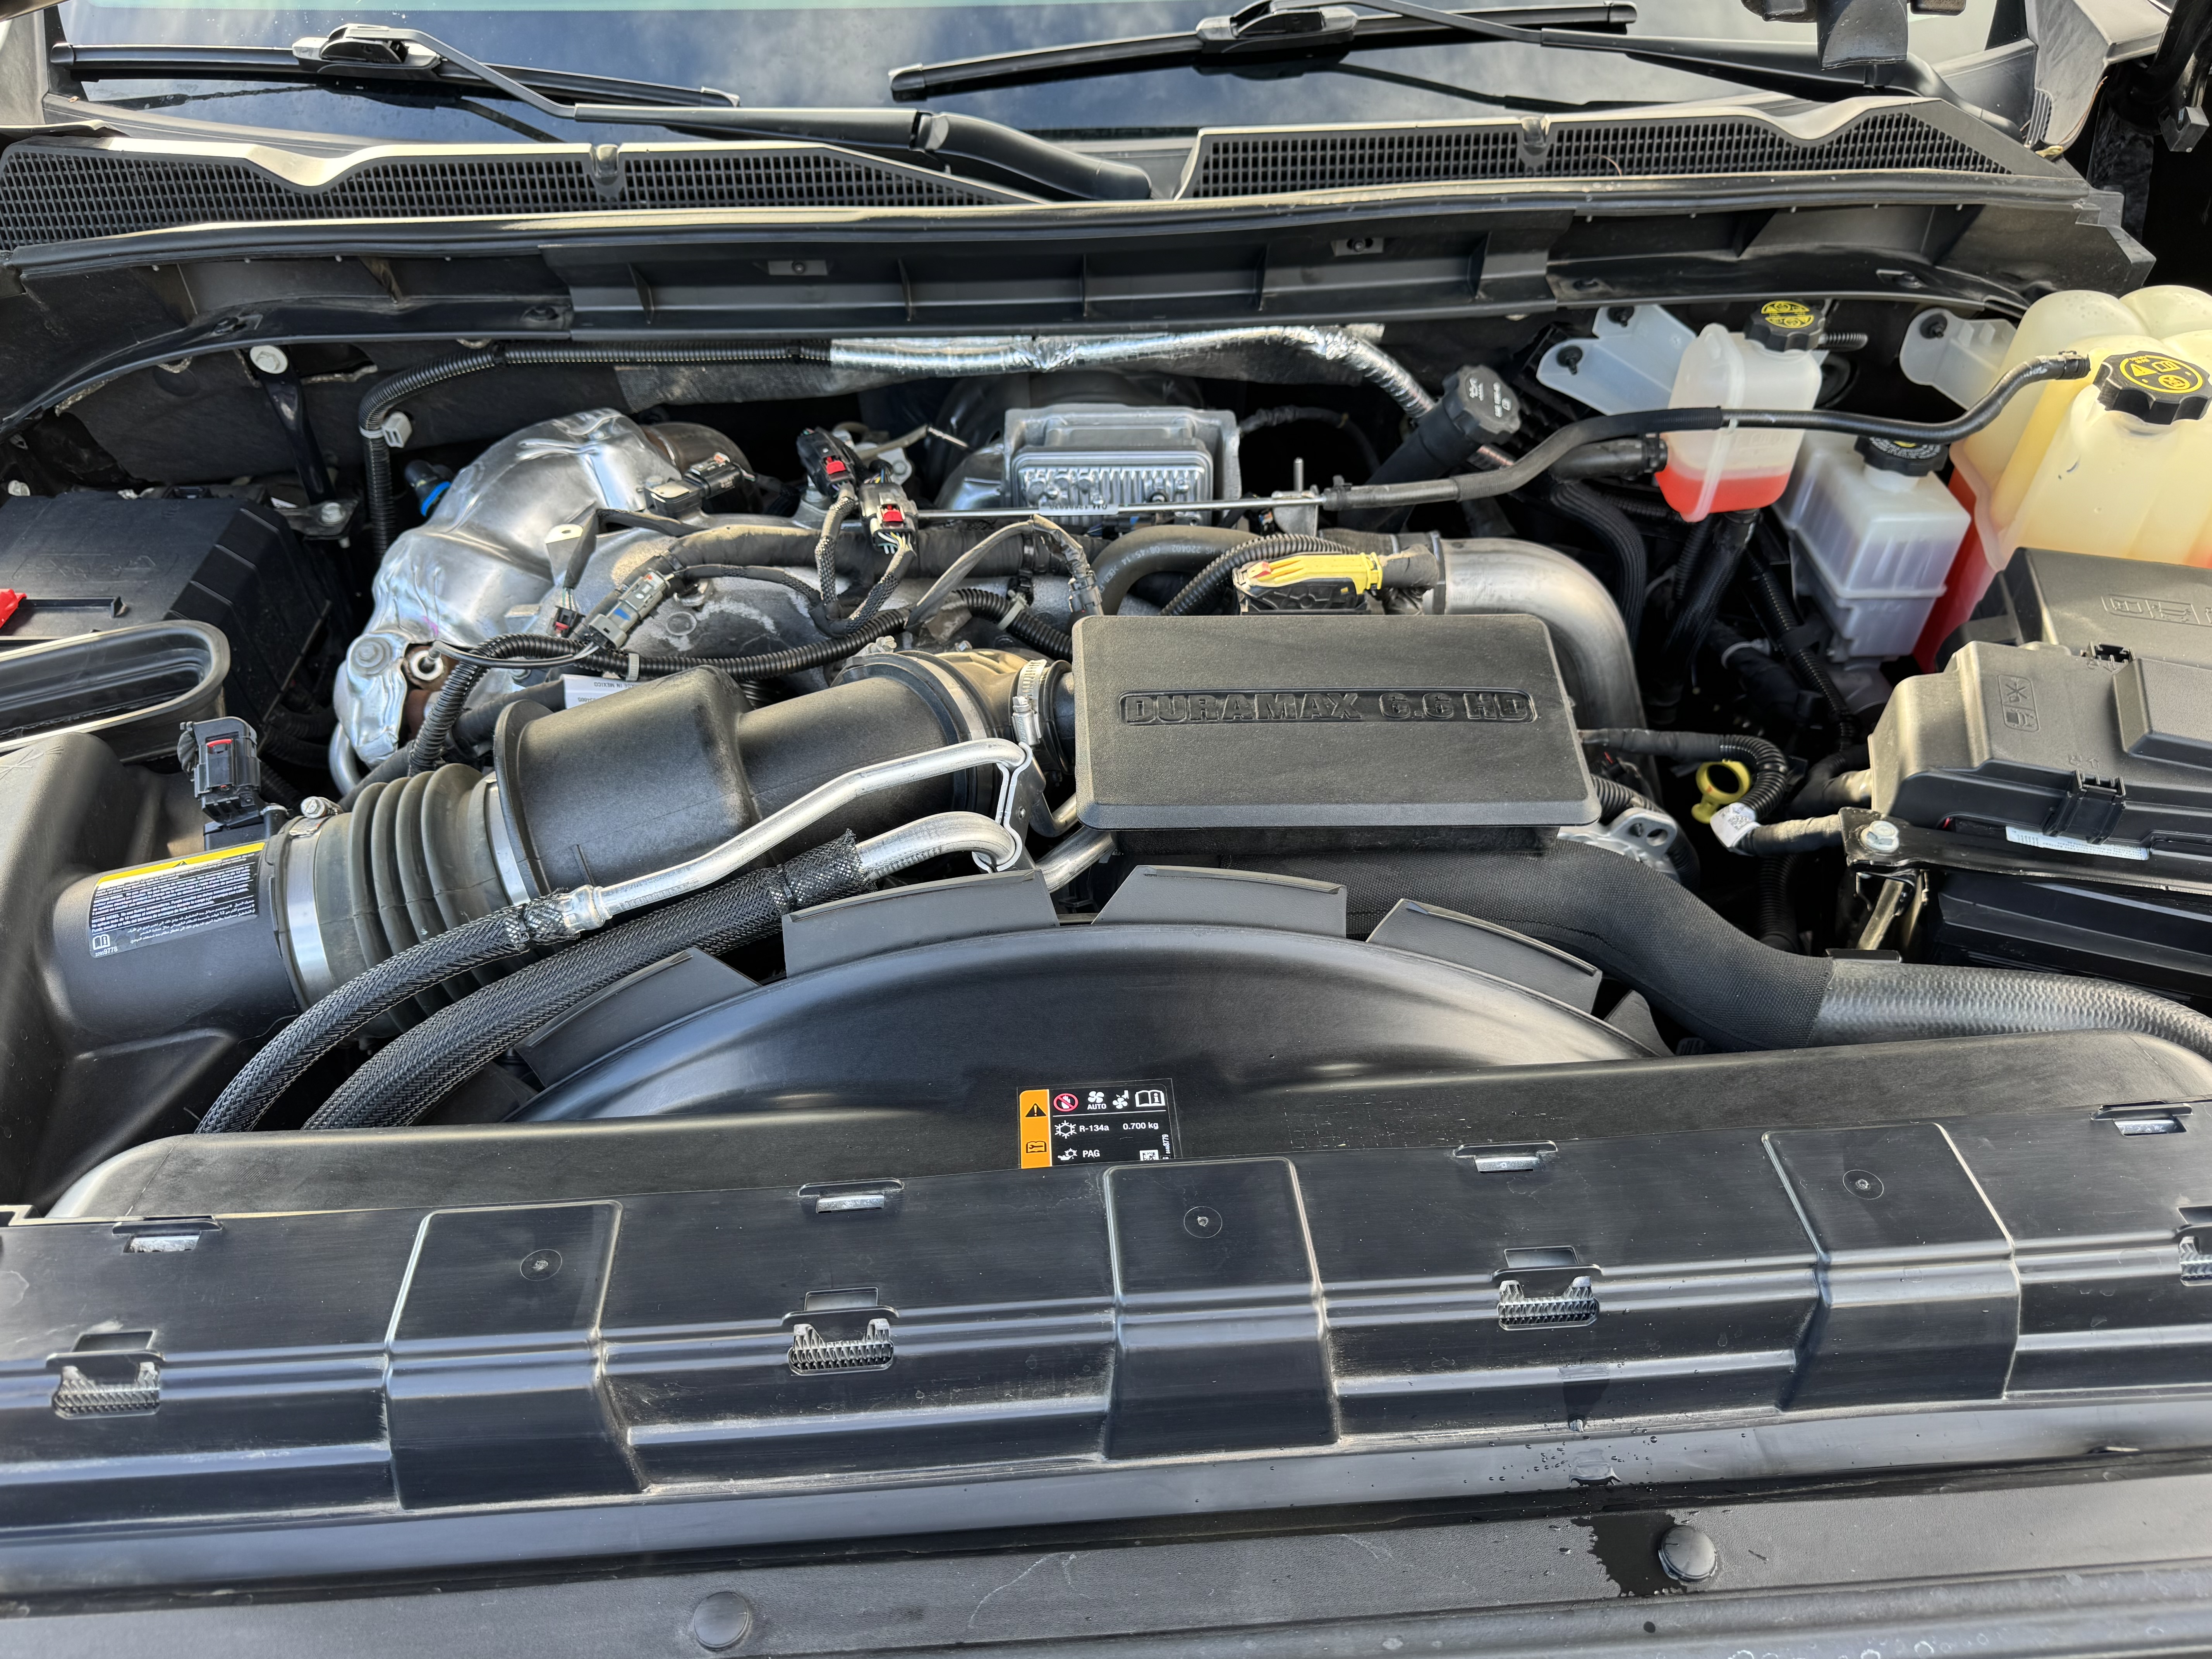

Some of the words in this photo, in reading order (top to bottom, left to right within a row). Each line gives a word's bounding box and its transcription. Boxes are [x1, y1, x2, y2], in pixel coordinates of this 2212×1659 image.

[1171, 544, 1200, 553] 220402
[1126, 693, 1361, 723] DURAMAX
[1379, 692, 1454, 720] 6.6
[1467, 693, 1530, 720] HD
[1082, 1150, 1100, 1158] PAG
